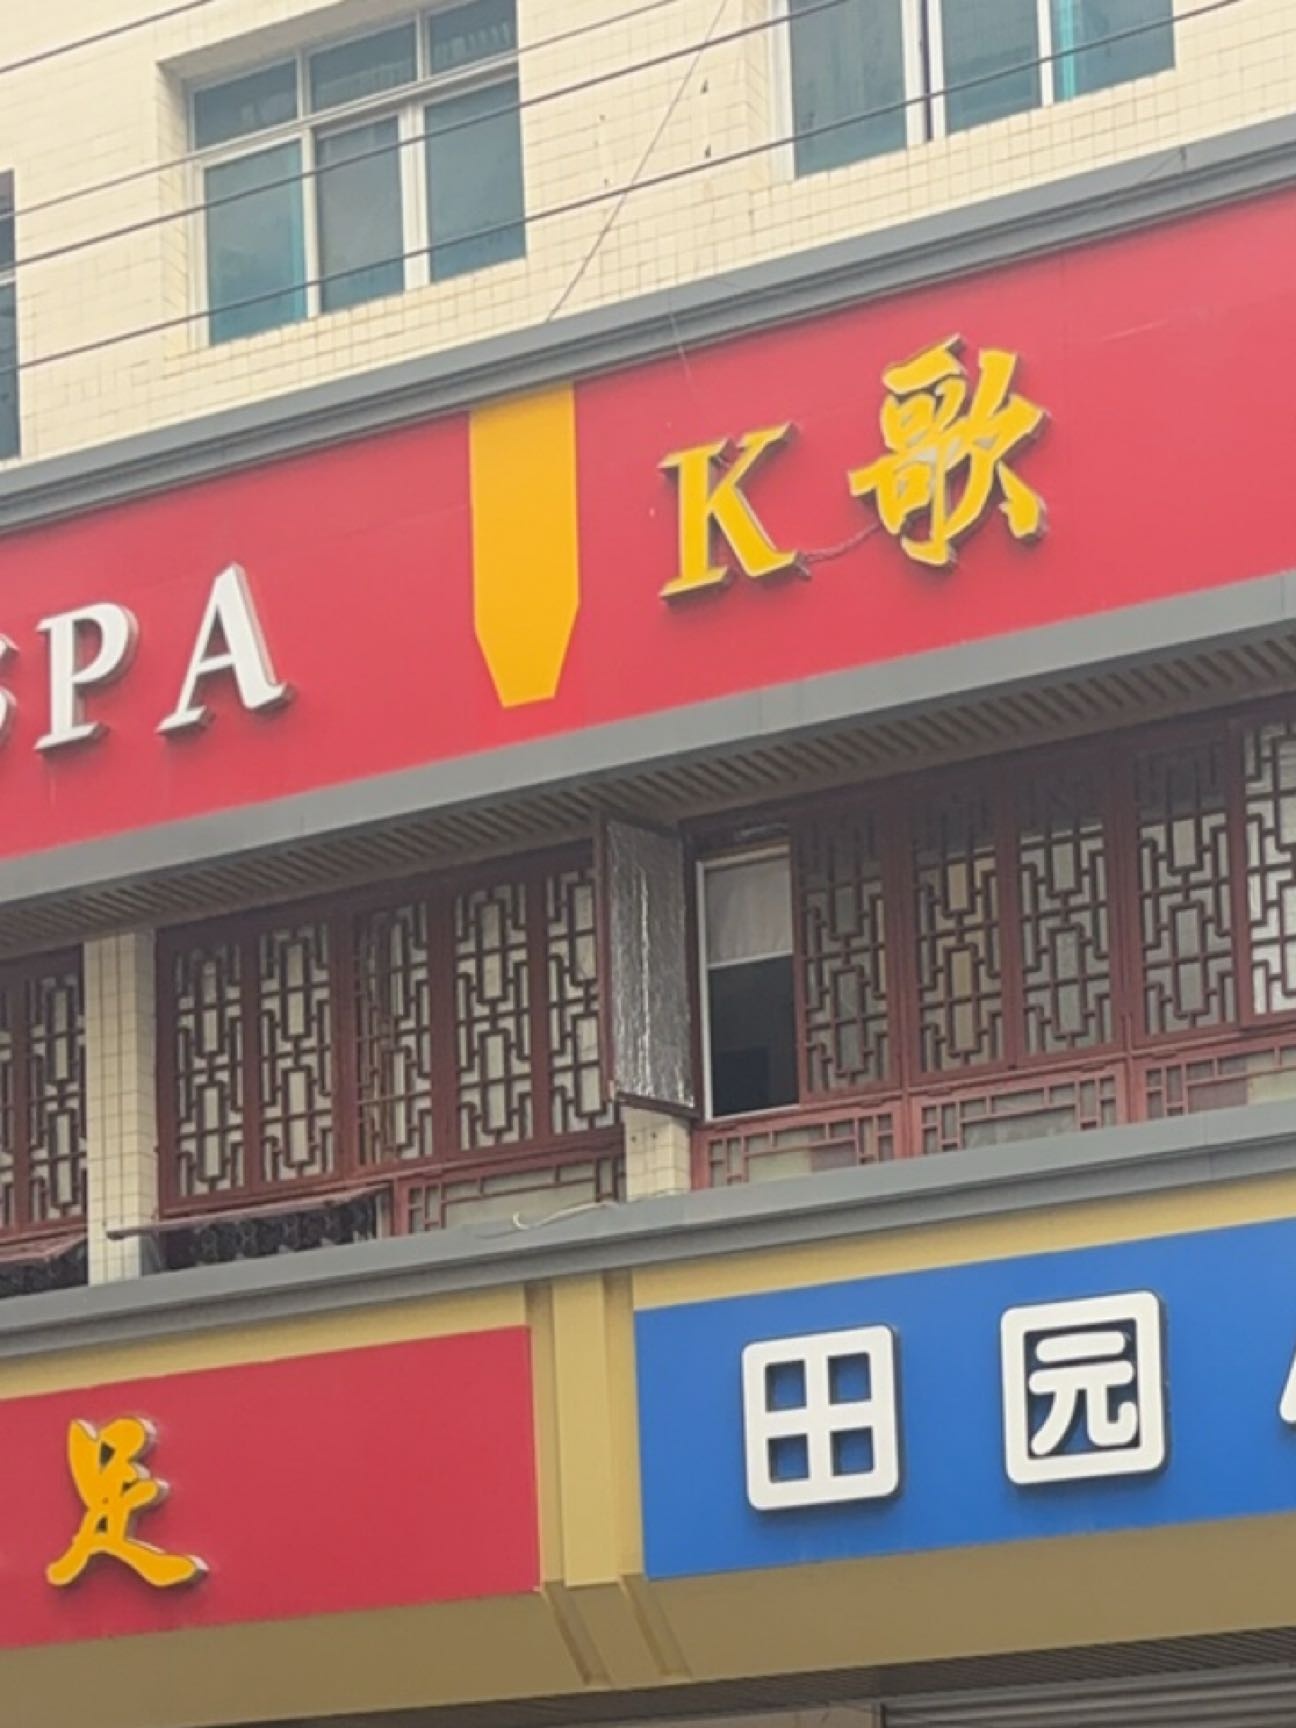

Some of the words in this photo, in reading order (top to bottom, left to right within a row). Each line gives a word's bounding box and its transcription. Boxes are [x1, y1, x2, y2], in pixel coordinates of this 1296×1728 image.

[658, 333, 1048, 599] K歌
[0, 562, 288, 751] PA
[46, 1416, 207, 1587] 足
